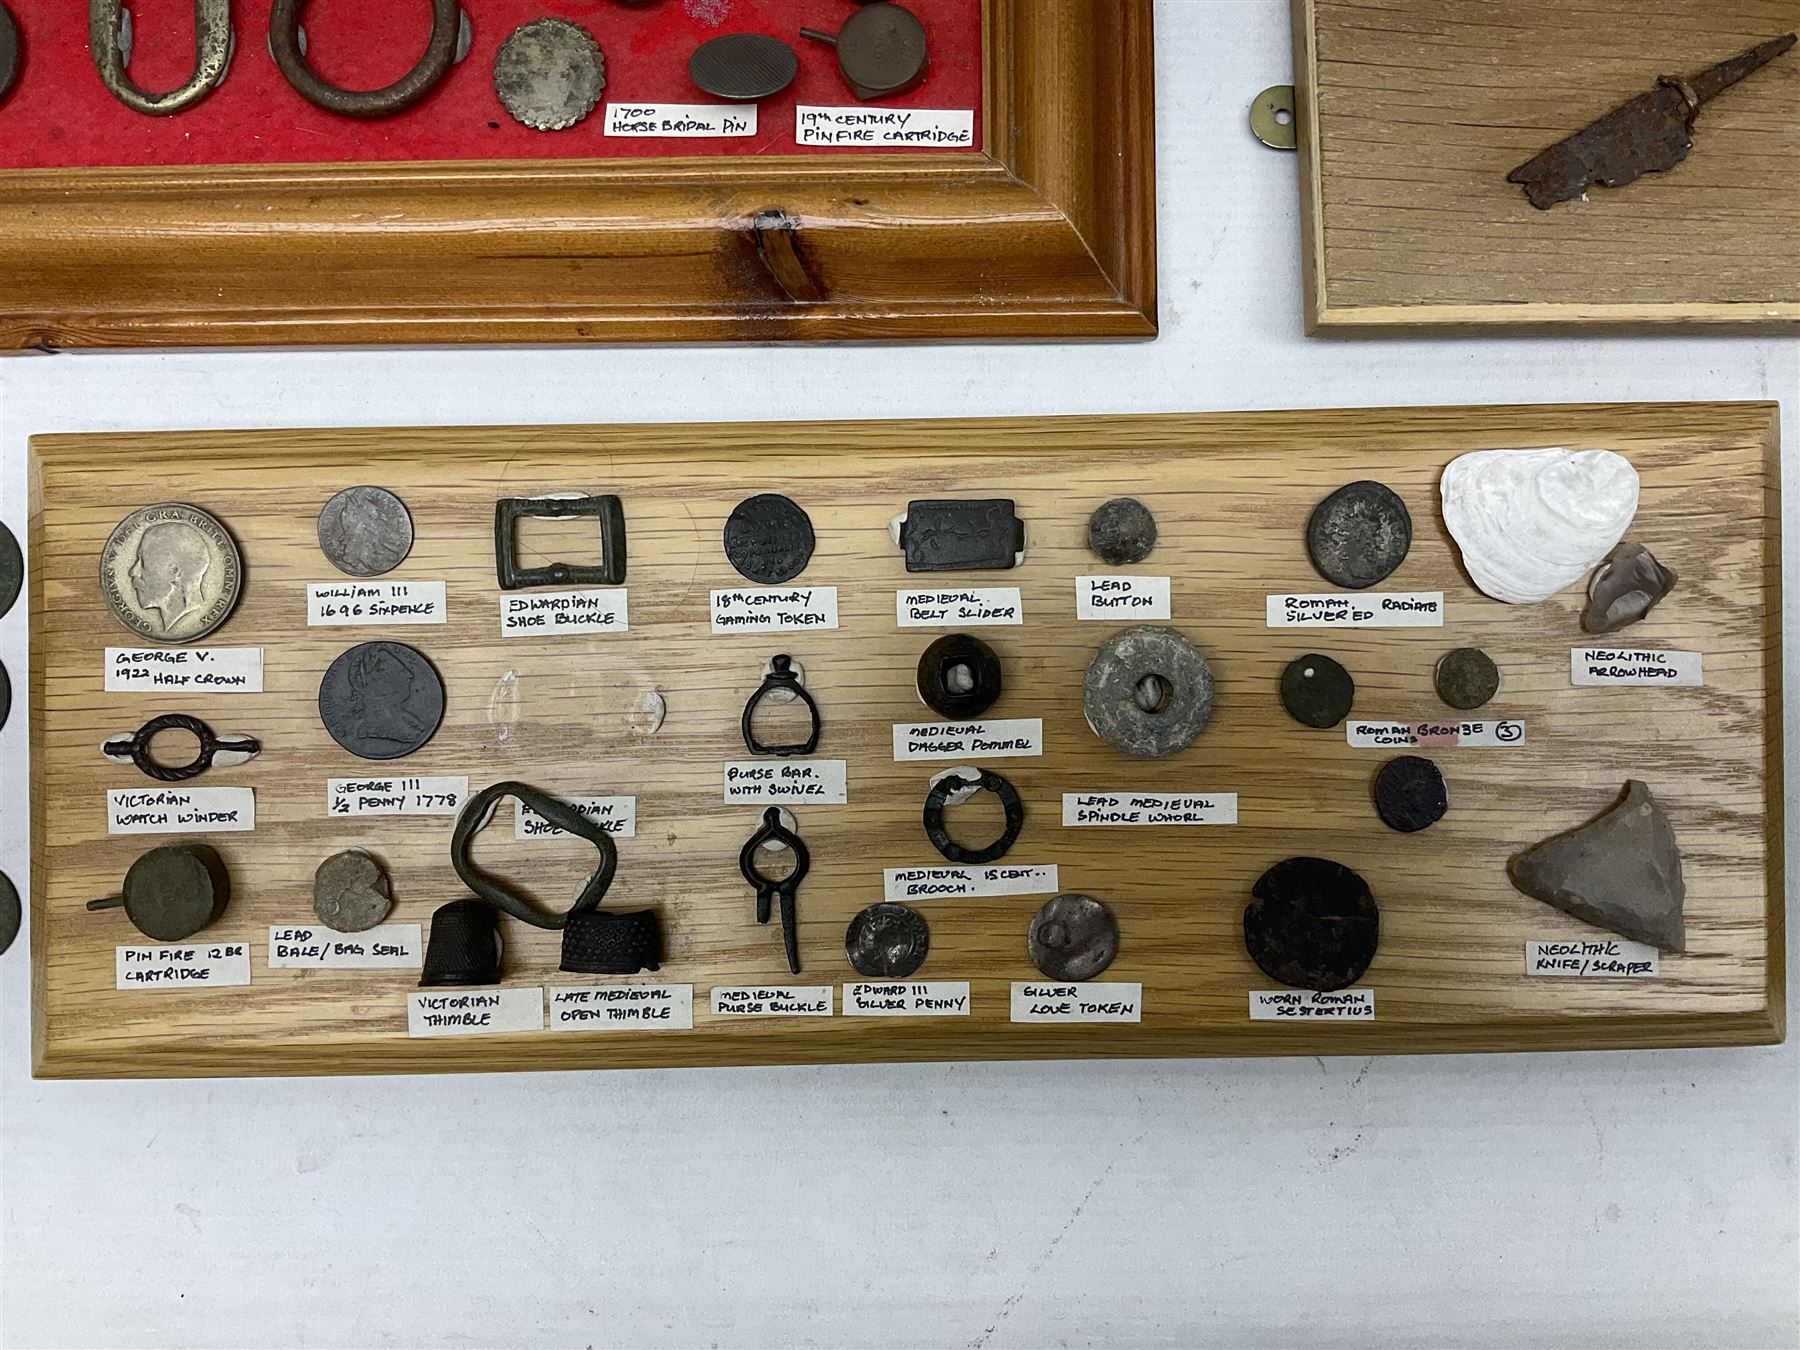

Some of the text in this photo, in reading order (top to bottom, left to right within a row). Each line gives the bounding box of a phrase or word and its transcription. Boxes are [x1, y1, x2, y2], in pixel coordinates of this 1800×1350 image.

[614, 108, 656, 119] 1700
[613, 121, 657, 132] HORSE
[836, 113, 911, 129] CENTURY
[883, 125, 970, 143] CARTRIDGE
[1091, 580, 1132, 591] LEAD
[745, 591, 812, 607] CENTURY
[1091, 595, 1153, 607] BUTTON
[321, 604, 362, 617] 1696
[910, 608, 948, 619] BELT
[506, 612, 615, 627] SHOE BUCKLE
[777, 612, 826, 625] TOKEN
[116, 652, 188, 664] GEORGE
[1585, 650, 1667, 663] NEOLITHIC
[116, 668, 246, 686] 1922 HALF CROWN
[1356, 725, 1411, 736] ROMAN
[908, 739, 1032, 753] DAGGER POMMEL
[727, 767, 774, 781] PURSE
[335, 781, 393, 794] GEORGE
[729, 785, 762, 795] WITH
[359, 795, 405, 810] PENNY
[417, 793, 457, 807] 1778
[1077, 796, 1215, 810] LEAD MEDIEVAL
[116, 813, 168, 825] WATCH
[1148, 813, 1204, 823] WHORL
[895, 870, 971, 882] MEDIEVAL
[274, 930, 313, 942] LEAD
[372, 943, 409, 956] SEAL
[1538, 941, 1621, 956] NEOLITHIC
[125, 951, 152, 961] PIN
[160, 950, 195, 961] FIRE
[125, 967, 210, 982] CARTRIDGE
[555, 991, 590, 1003] LATE
[720, 990, 795, 1000] MEDIEVAL
[1023, 986, 1078, 998] SILVER
[1260, 992, 1365, 1005] WORN ROMAN
[418, 995, 499, 1010] VICTORIAN
[718, 1001, 827, 1013] PURSE BUCKLE
[856, 996, 966, 1011] SILVER PENNY
[1030, 1002, 1133, 1015] LOVE TOKEN
[560, 1006, 671, 1021] OPEN THIMBLE
[1276, 1005, 1372, 1016] SESTERTIUS
[423, 1013, 491, 1026] THIMBLE
